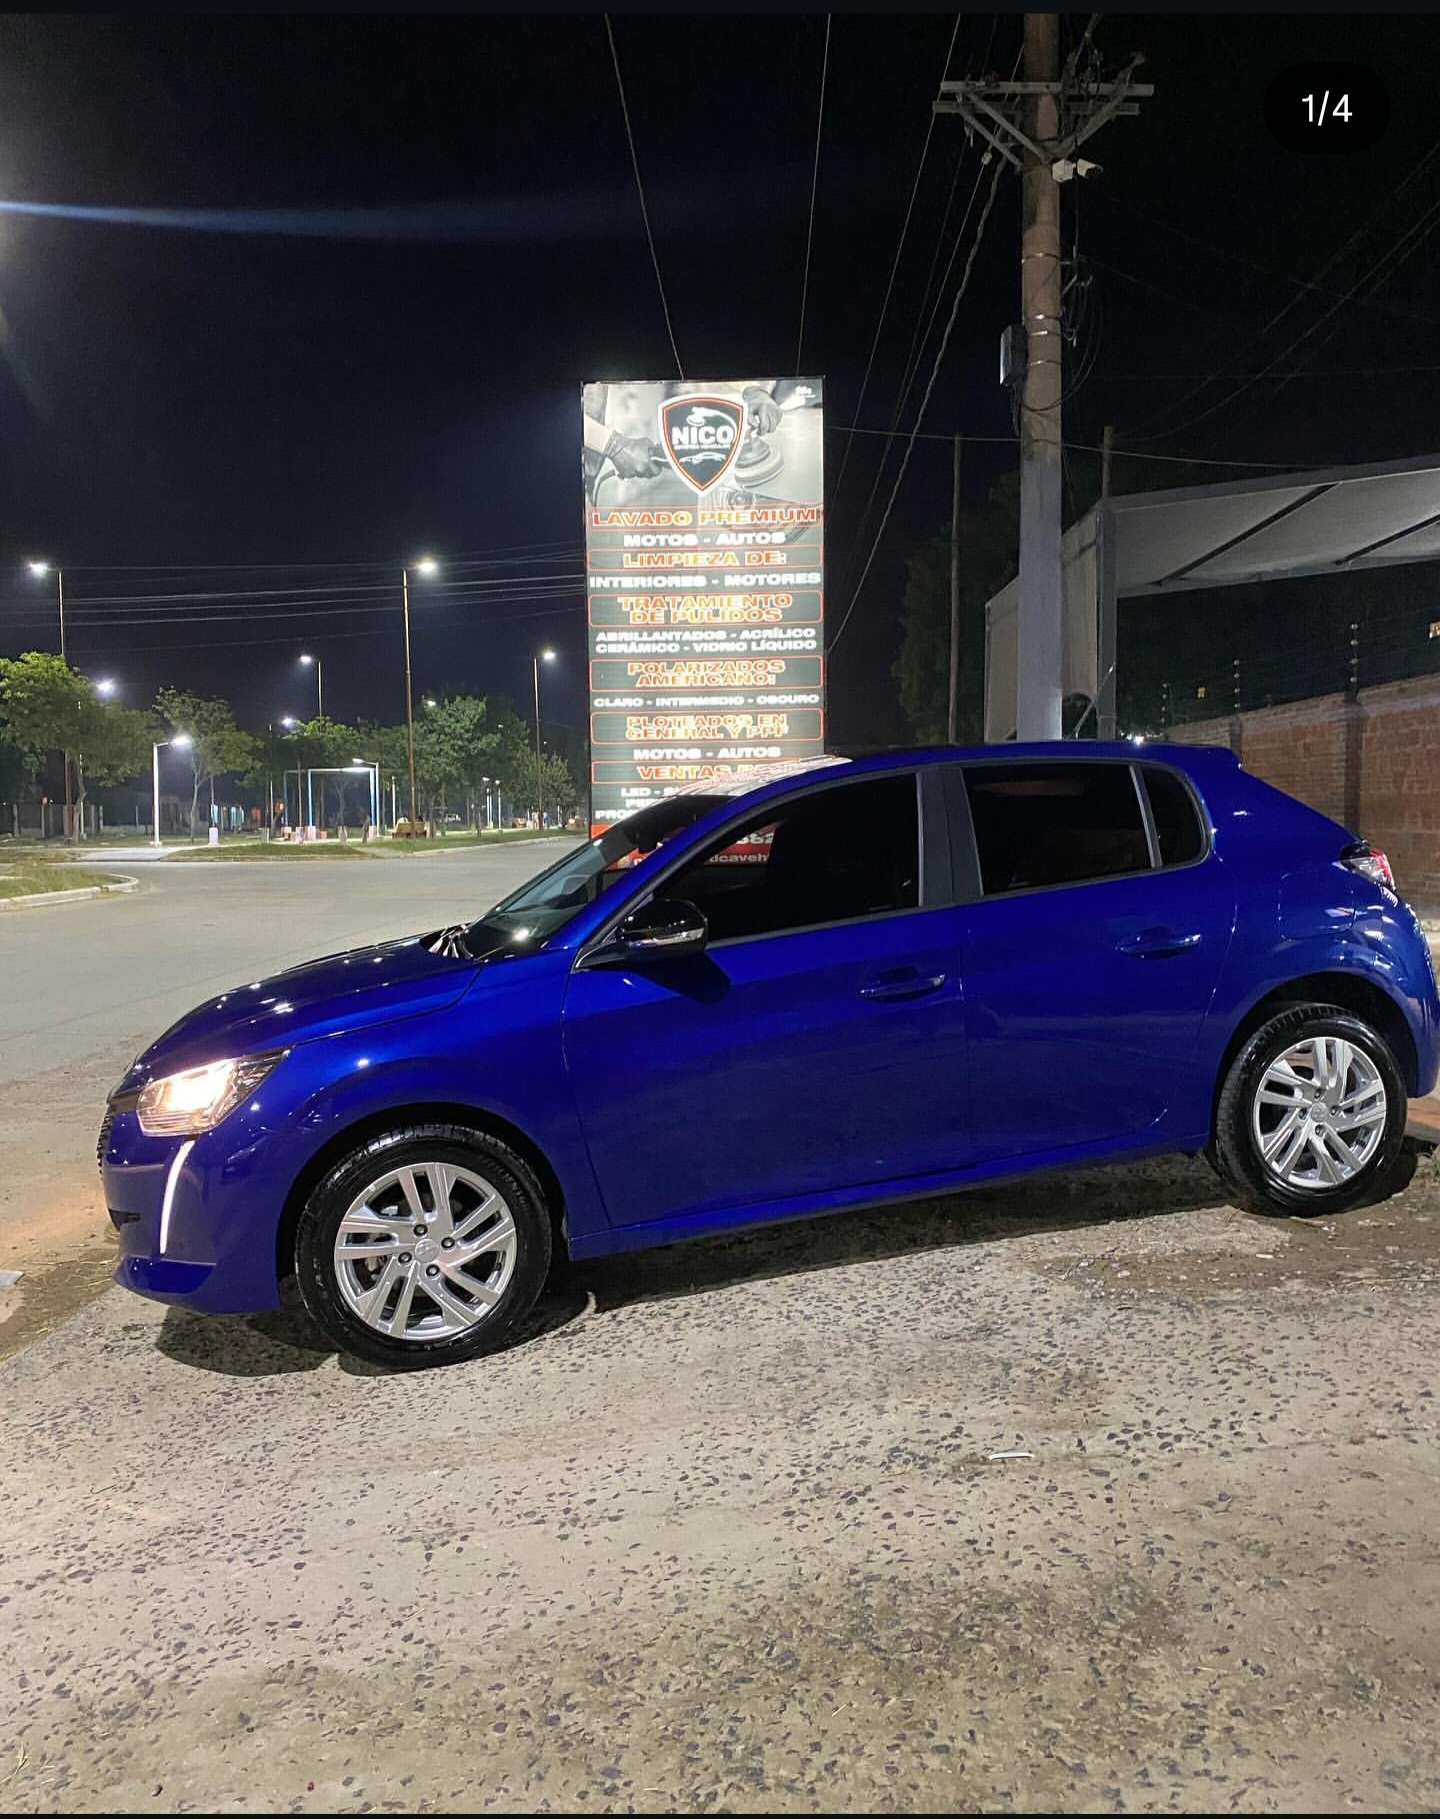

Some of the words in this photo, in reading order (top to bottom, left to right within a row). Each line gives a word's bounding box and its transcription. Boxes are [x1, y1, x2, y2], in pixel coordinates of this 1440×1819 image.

[672, 426, 734, 445] NICO
[593, 510, 692, 527] LAVADO
[699, 508, 817, 525] PREMIUM
[623, 533, 698, 547] MOTOS
[715, 532, 786, 545] AUTOS
[623, 552, 739, 568] LIMPIEZA
[745, 550, 787, 566] DE:
[589, 575, 707, 588] INTERIORES
[724, 573, 821, 587] MOTORES
[617, 593, 792, 611] TRATAMIENTO
[630, 609, 665, 624] DE
[671, 608, 782, 623] PULIDOS
[595, 630, 727, 642] ABRILLANTADOS
[740, 627, 816, 639] ACRÍLICO
[595, 641, 680, 654] CERÁMICO
[693, 641, 747, 652] VIDRIO
[751, 639, 817, 651] LÍQUIDO
[627, 660, 785, 675] POLARIZADOS
[635, 672, 776, 687] AMERICANO:
[594, 697, 643, 708] CLARO
[656, 696, 744, 707] INTERMEDIO
[756, 694, 819, 705] OSCURO
[626, 715, 754, 728] PLOTEADOS
[757, 713, 787, 726] EN
[625, 726, 724, 740] GENERAL
[728, 726, 742, 738] Y
[746, 724, 788, 738] PPF
[633, 748, 702, 760] MOTOS
[718, 746, 781, 758] AUTOS
[636, 764, 728, 780] VENTAS
[621, 787, 651, 797] LED
